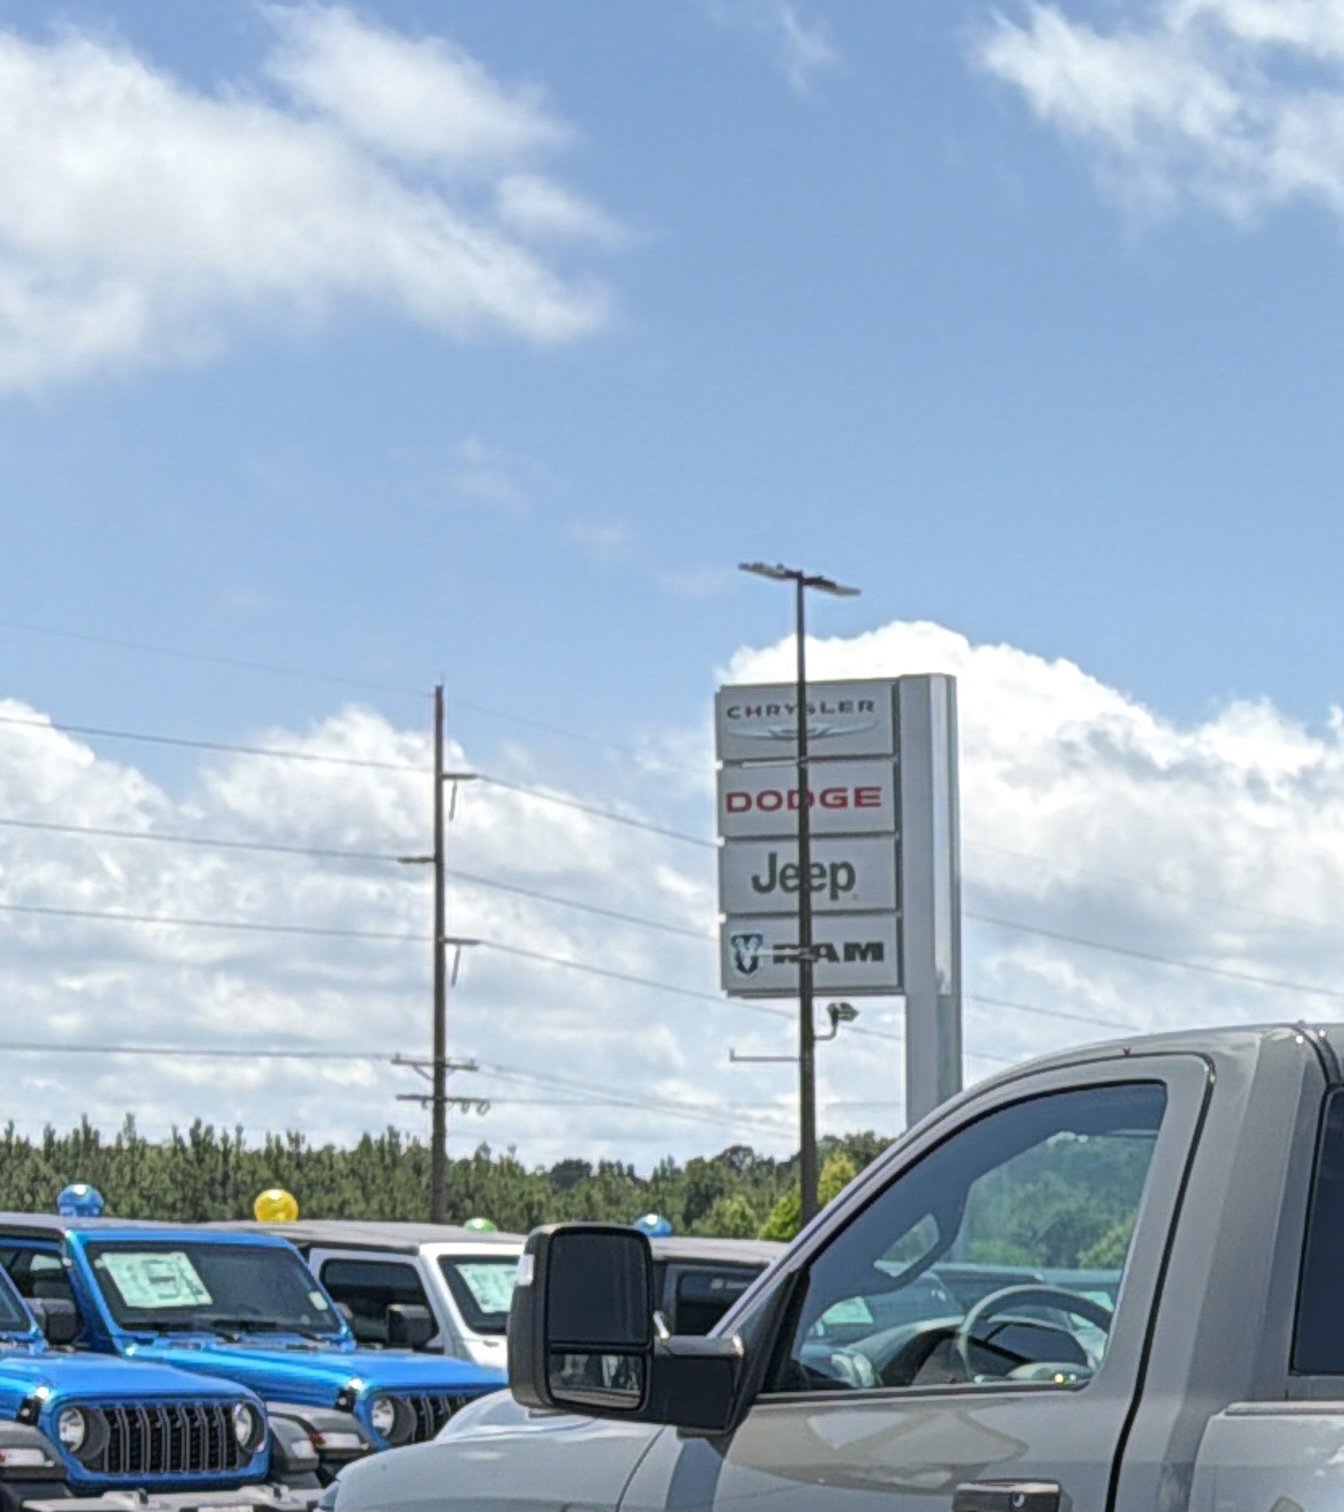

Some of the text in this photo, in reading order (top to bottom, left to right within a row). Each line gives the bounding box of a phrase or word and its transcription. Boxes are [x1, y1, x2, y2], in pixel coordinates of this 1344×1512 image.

[726, 700, 875, 720] CHRYSLER
[725, 786, 882, 814] DODGE
[751, 852, 856, 901] Jeep
[772, 942, 884, 964] RAM
